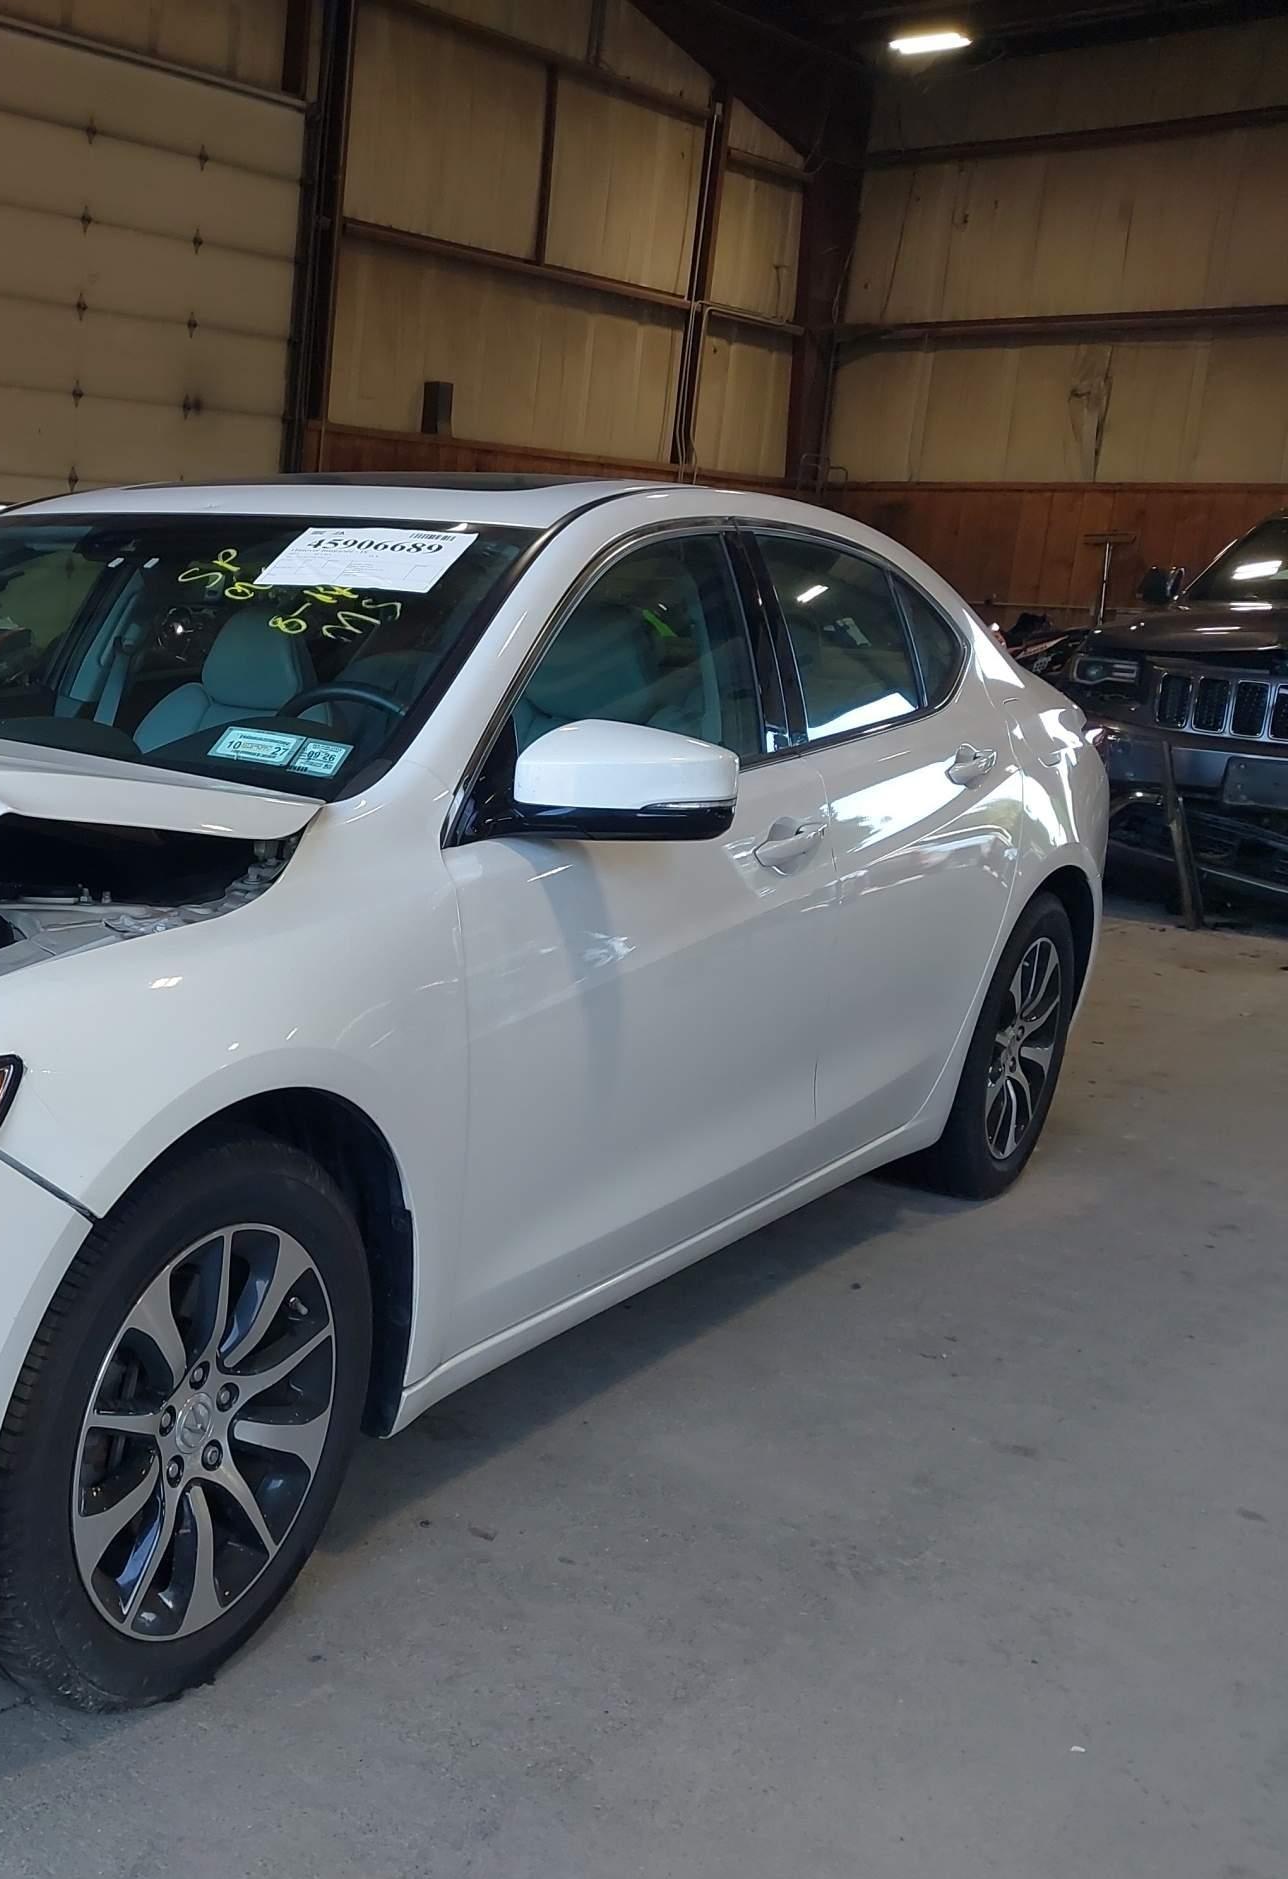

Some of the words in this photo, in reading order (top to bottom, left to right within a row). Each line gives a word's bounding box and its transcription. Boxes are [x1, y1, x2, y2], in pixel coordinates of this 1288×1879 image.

[306, 538, 444, 555] 45906689
[226, 739, 242, 750] 10
[271, 746, 289, 757] 27
